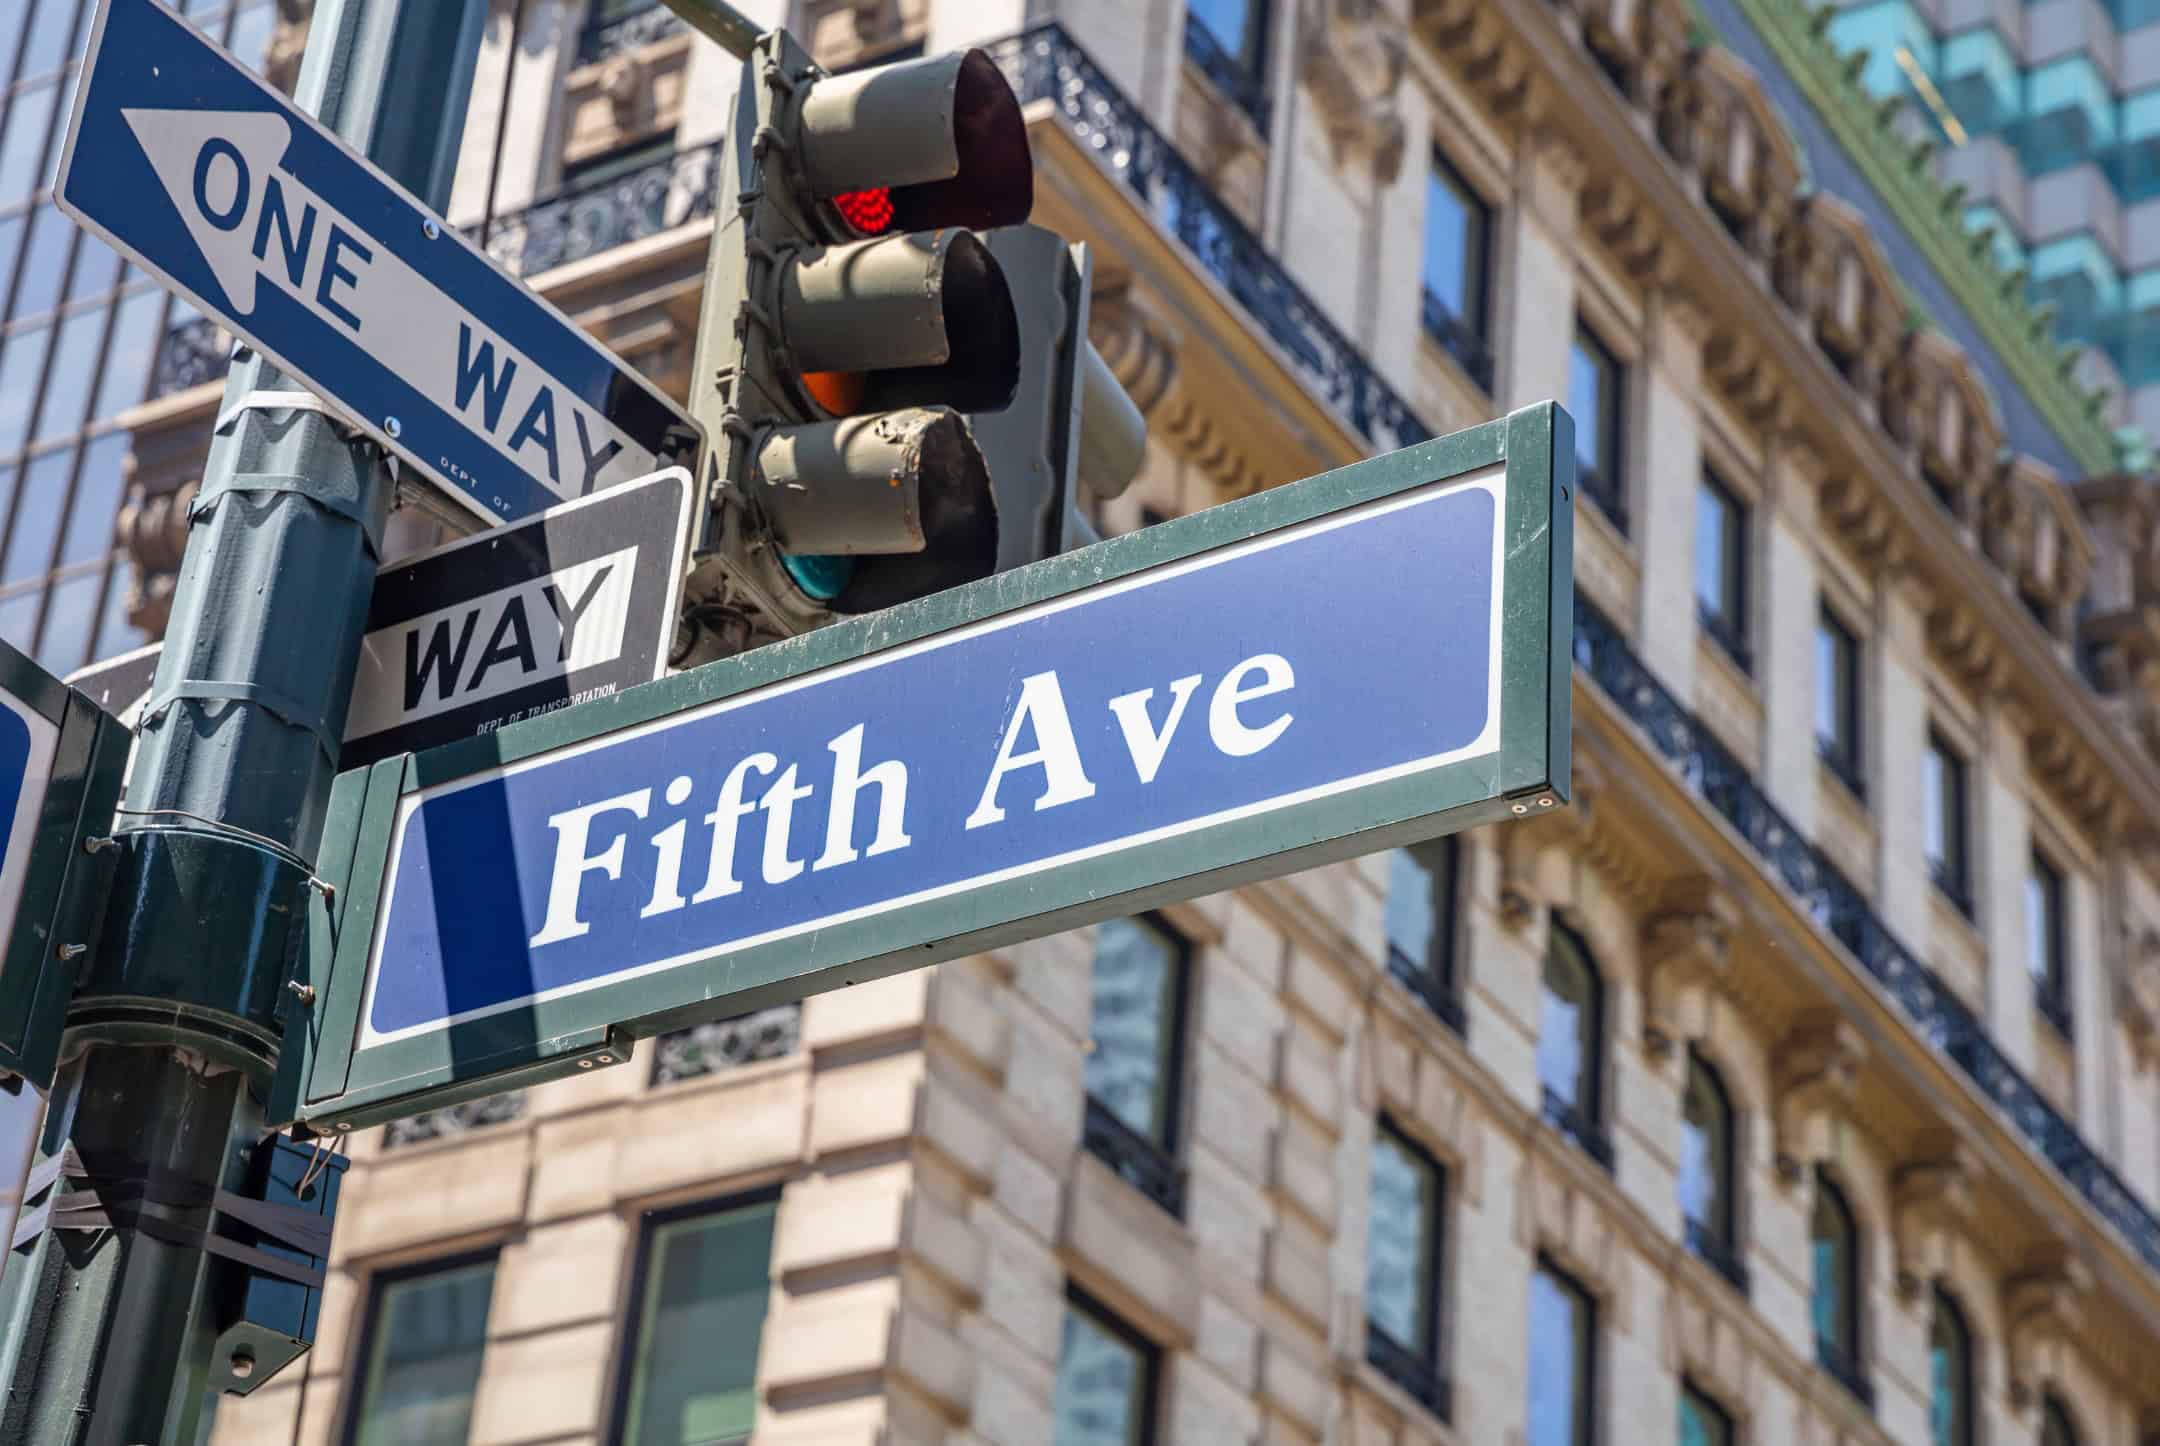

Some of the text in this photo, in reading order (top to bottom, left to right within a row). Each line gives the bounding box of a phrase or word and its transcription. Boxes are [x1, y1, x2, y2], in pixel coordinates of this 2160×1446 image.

[193, 137, 624, 498] ONE WAY
[440, 455, 512, 512] DEPT OF
[404, 564, 615, 712] WAY
[528, 682, 617, 719] TRANSPORTATION
[529, 653, 1296, 948] Fifth Ave
